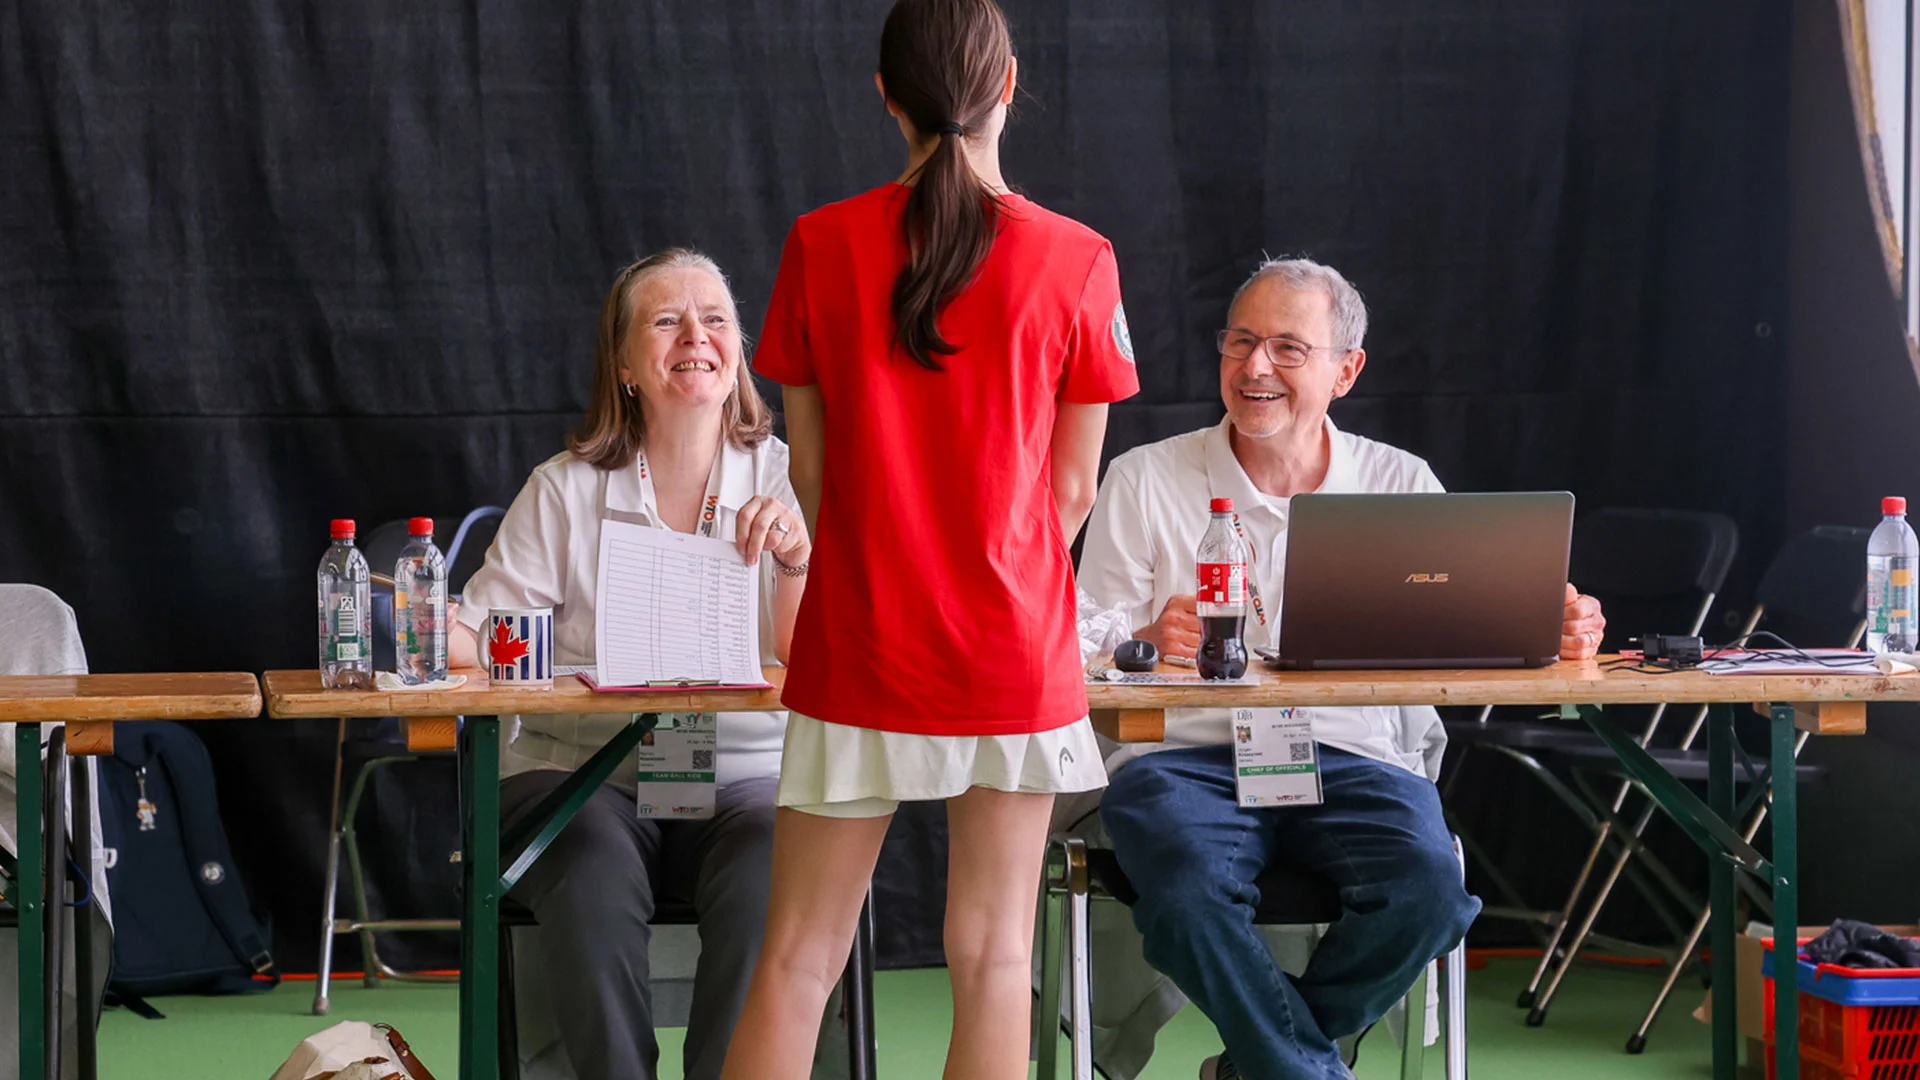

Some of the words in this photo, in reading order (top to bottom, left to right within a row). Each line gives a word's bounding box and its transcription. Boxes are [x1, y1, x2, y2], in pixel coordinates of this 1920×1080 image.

[704, 495, 718, 521] WTO
[1405, 573, 1449, 583] ASUS
[1253, 598, 1266, 626] WTO
